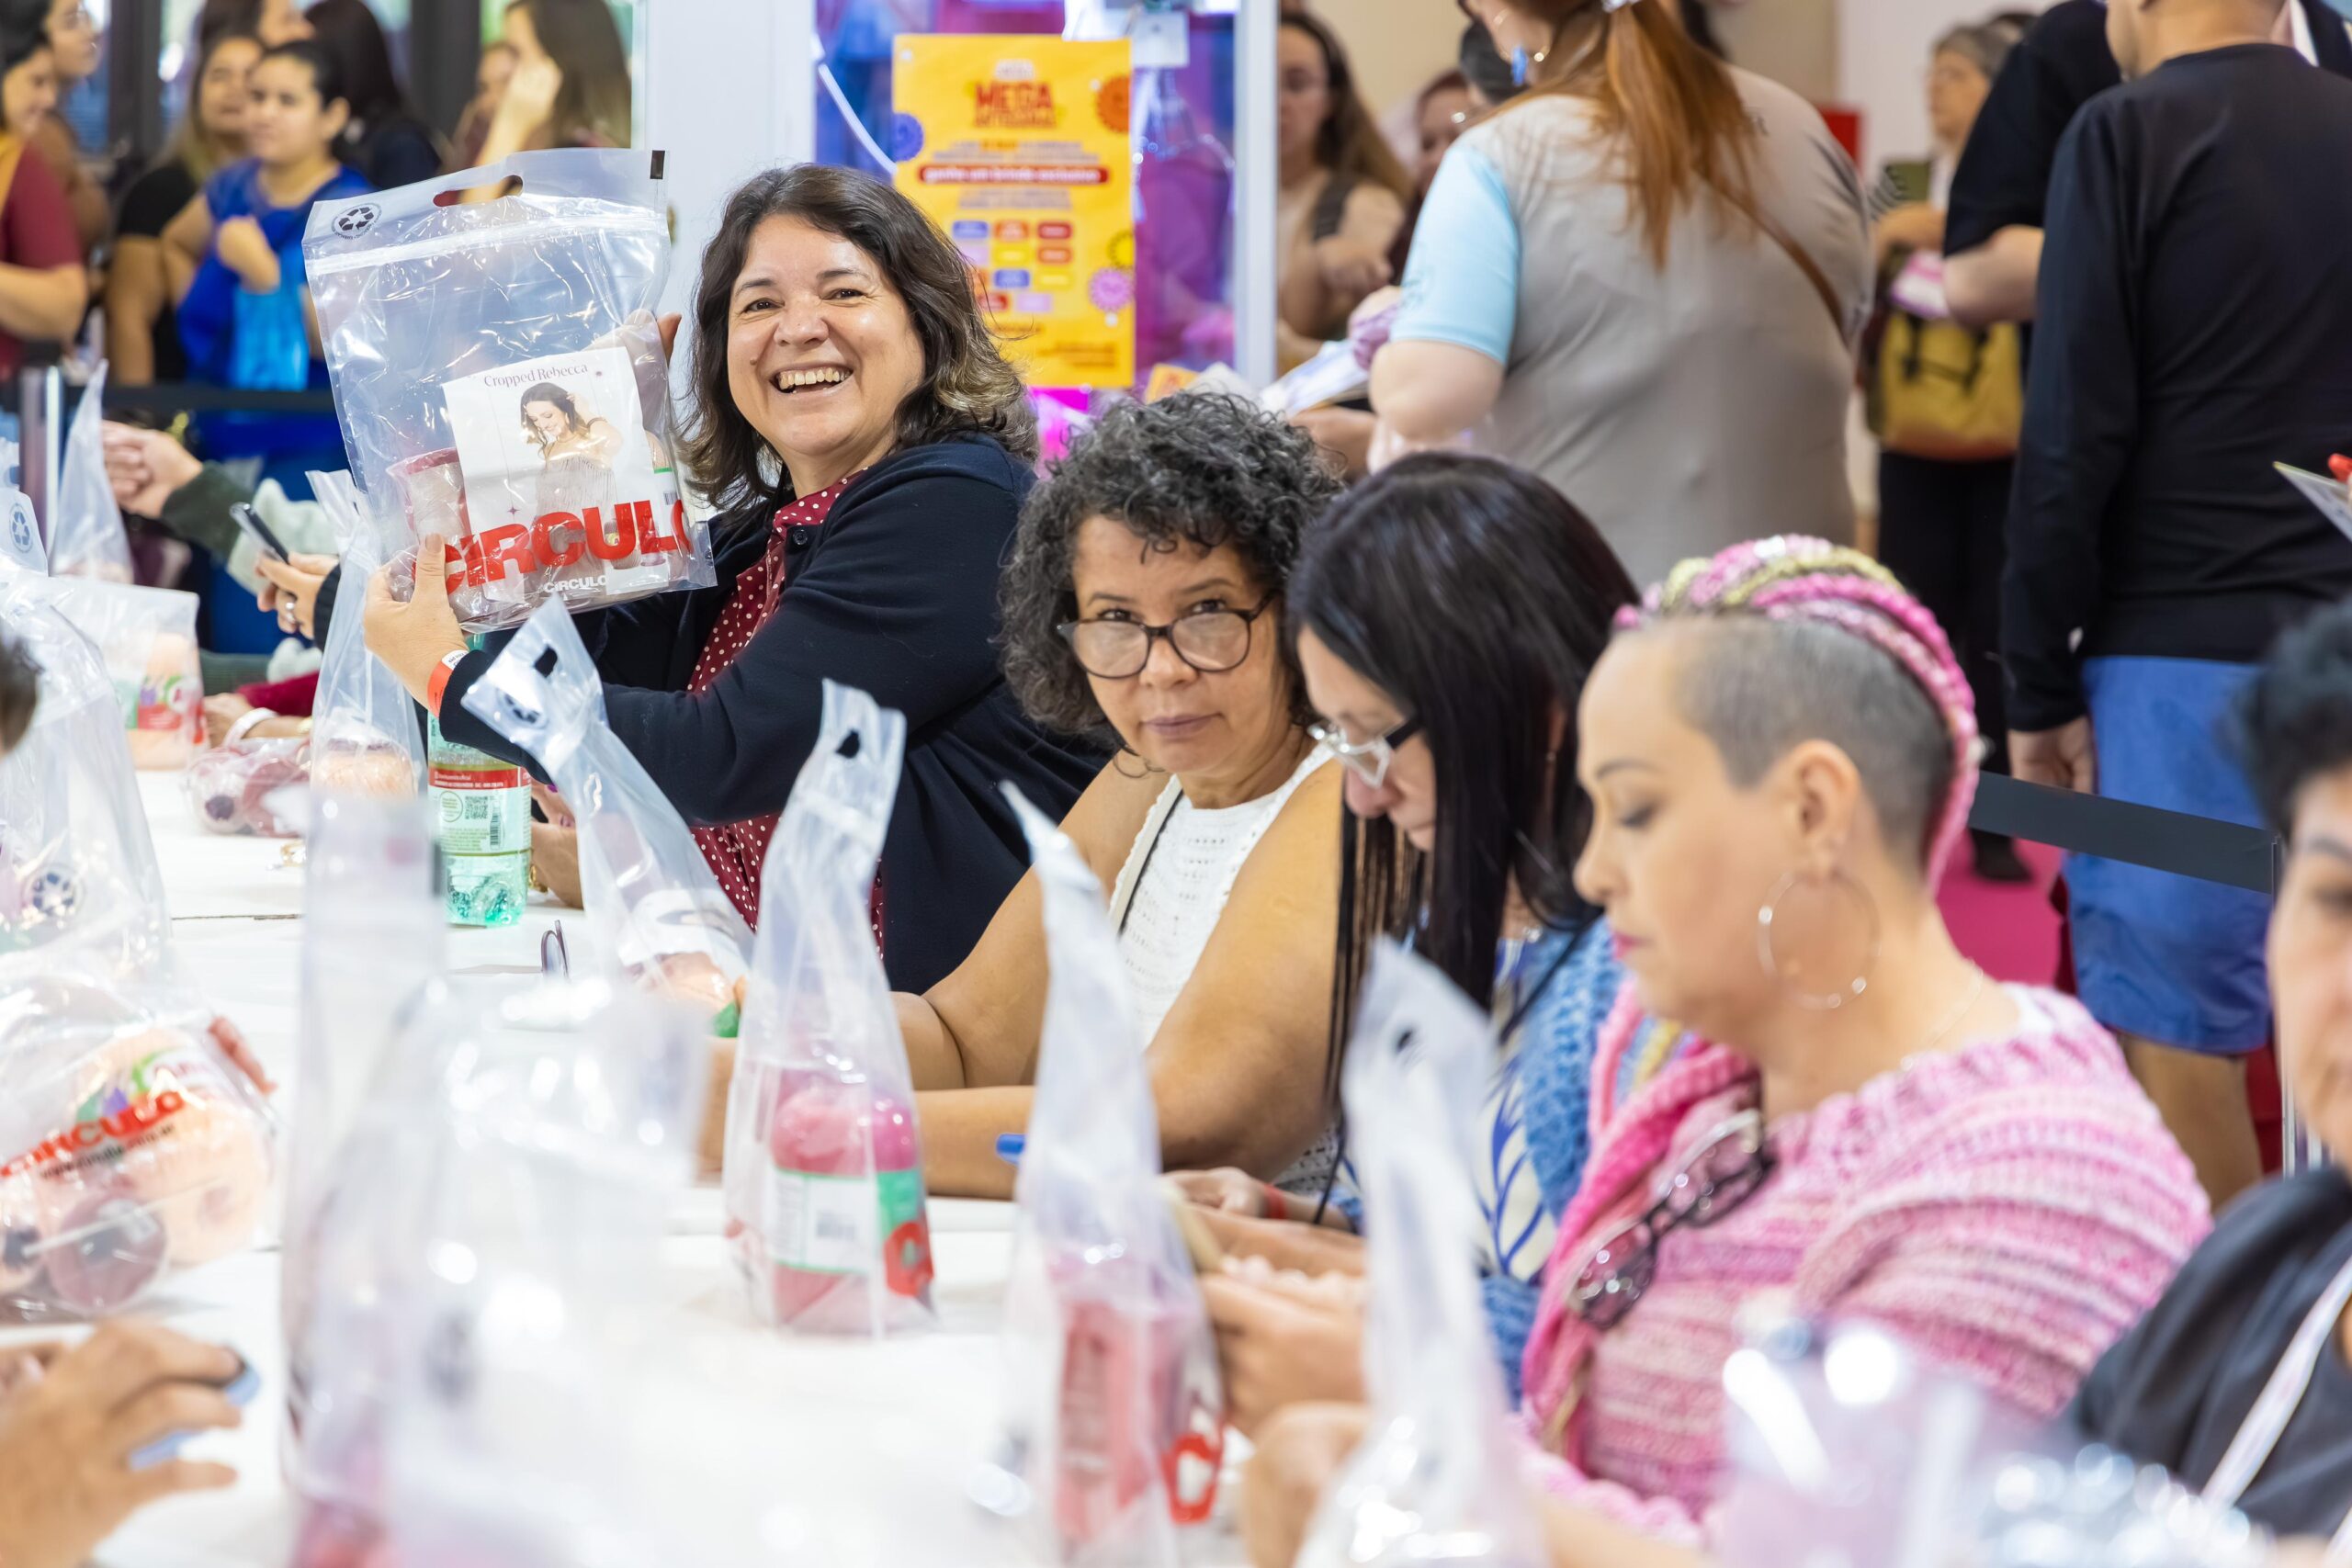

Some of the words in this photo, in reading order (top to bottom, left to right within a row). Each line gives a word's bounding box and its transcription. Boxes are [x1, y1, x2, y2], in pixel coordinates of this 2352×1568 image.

[976, 81, 1052, 110] MEGA
[484, 370, 536, 388] Cropped
[537, 364, 588, 381] Rebecca
